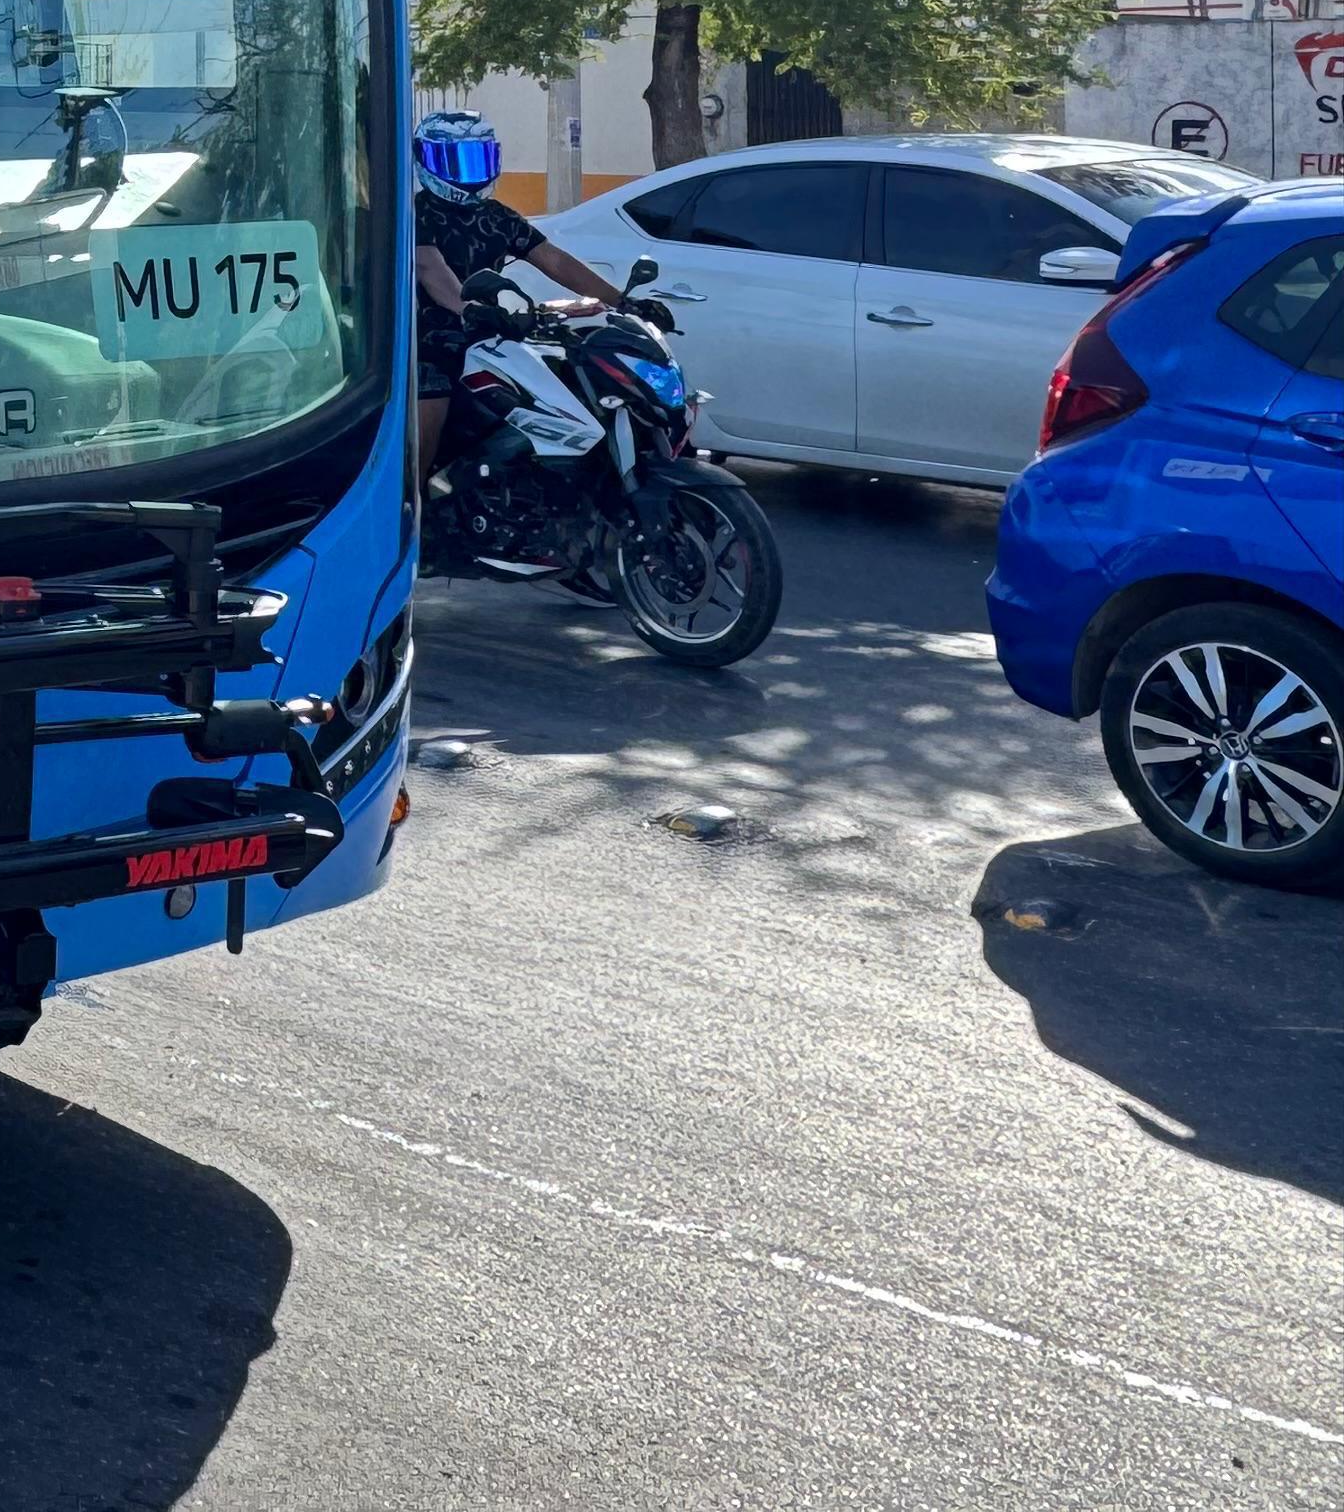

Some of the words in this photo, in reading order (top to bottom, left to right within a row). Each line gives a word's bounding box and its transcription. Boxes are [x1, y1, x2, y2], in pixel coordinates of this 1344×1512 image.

[1171, 119, 1209, 156] E
[113, 256, 201, 323] MU
[214, 251, 302, 314] 175
[126, 834, 268, 888] YAKIMA
